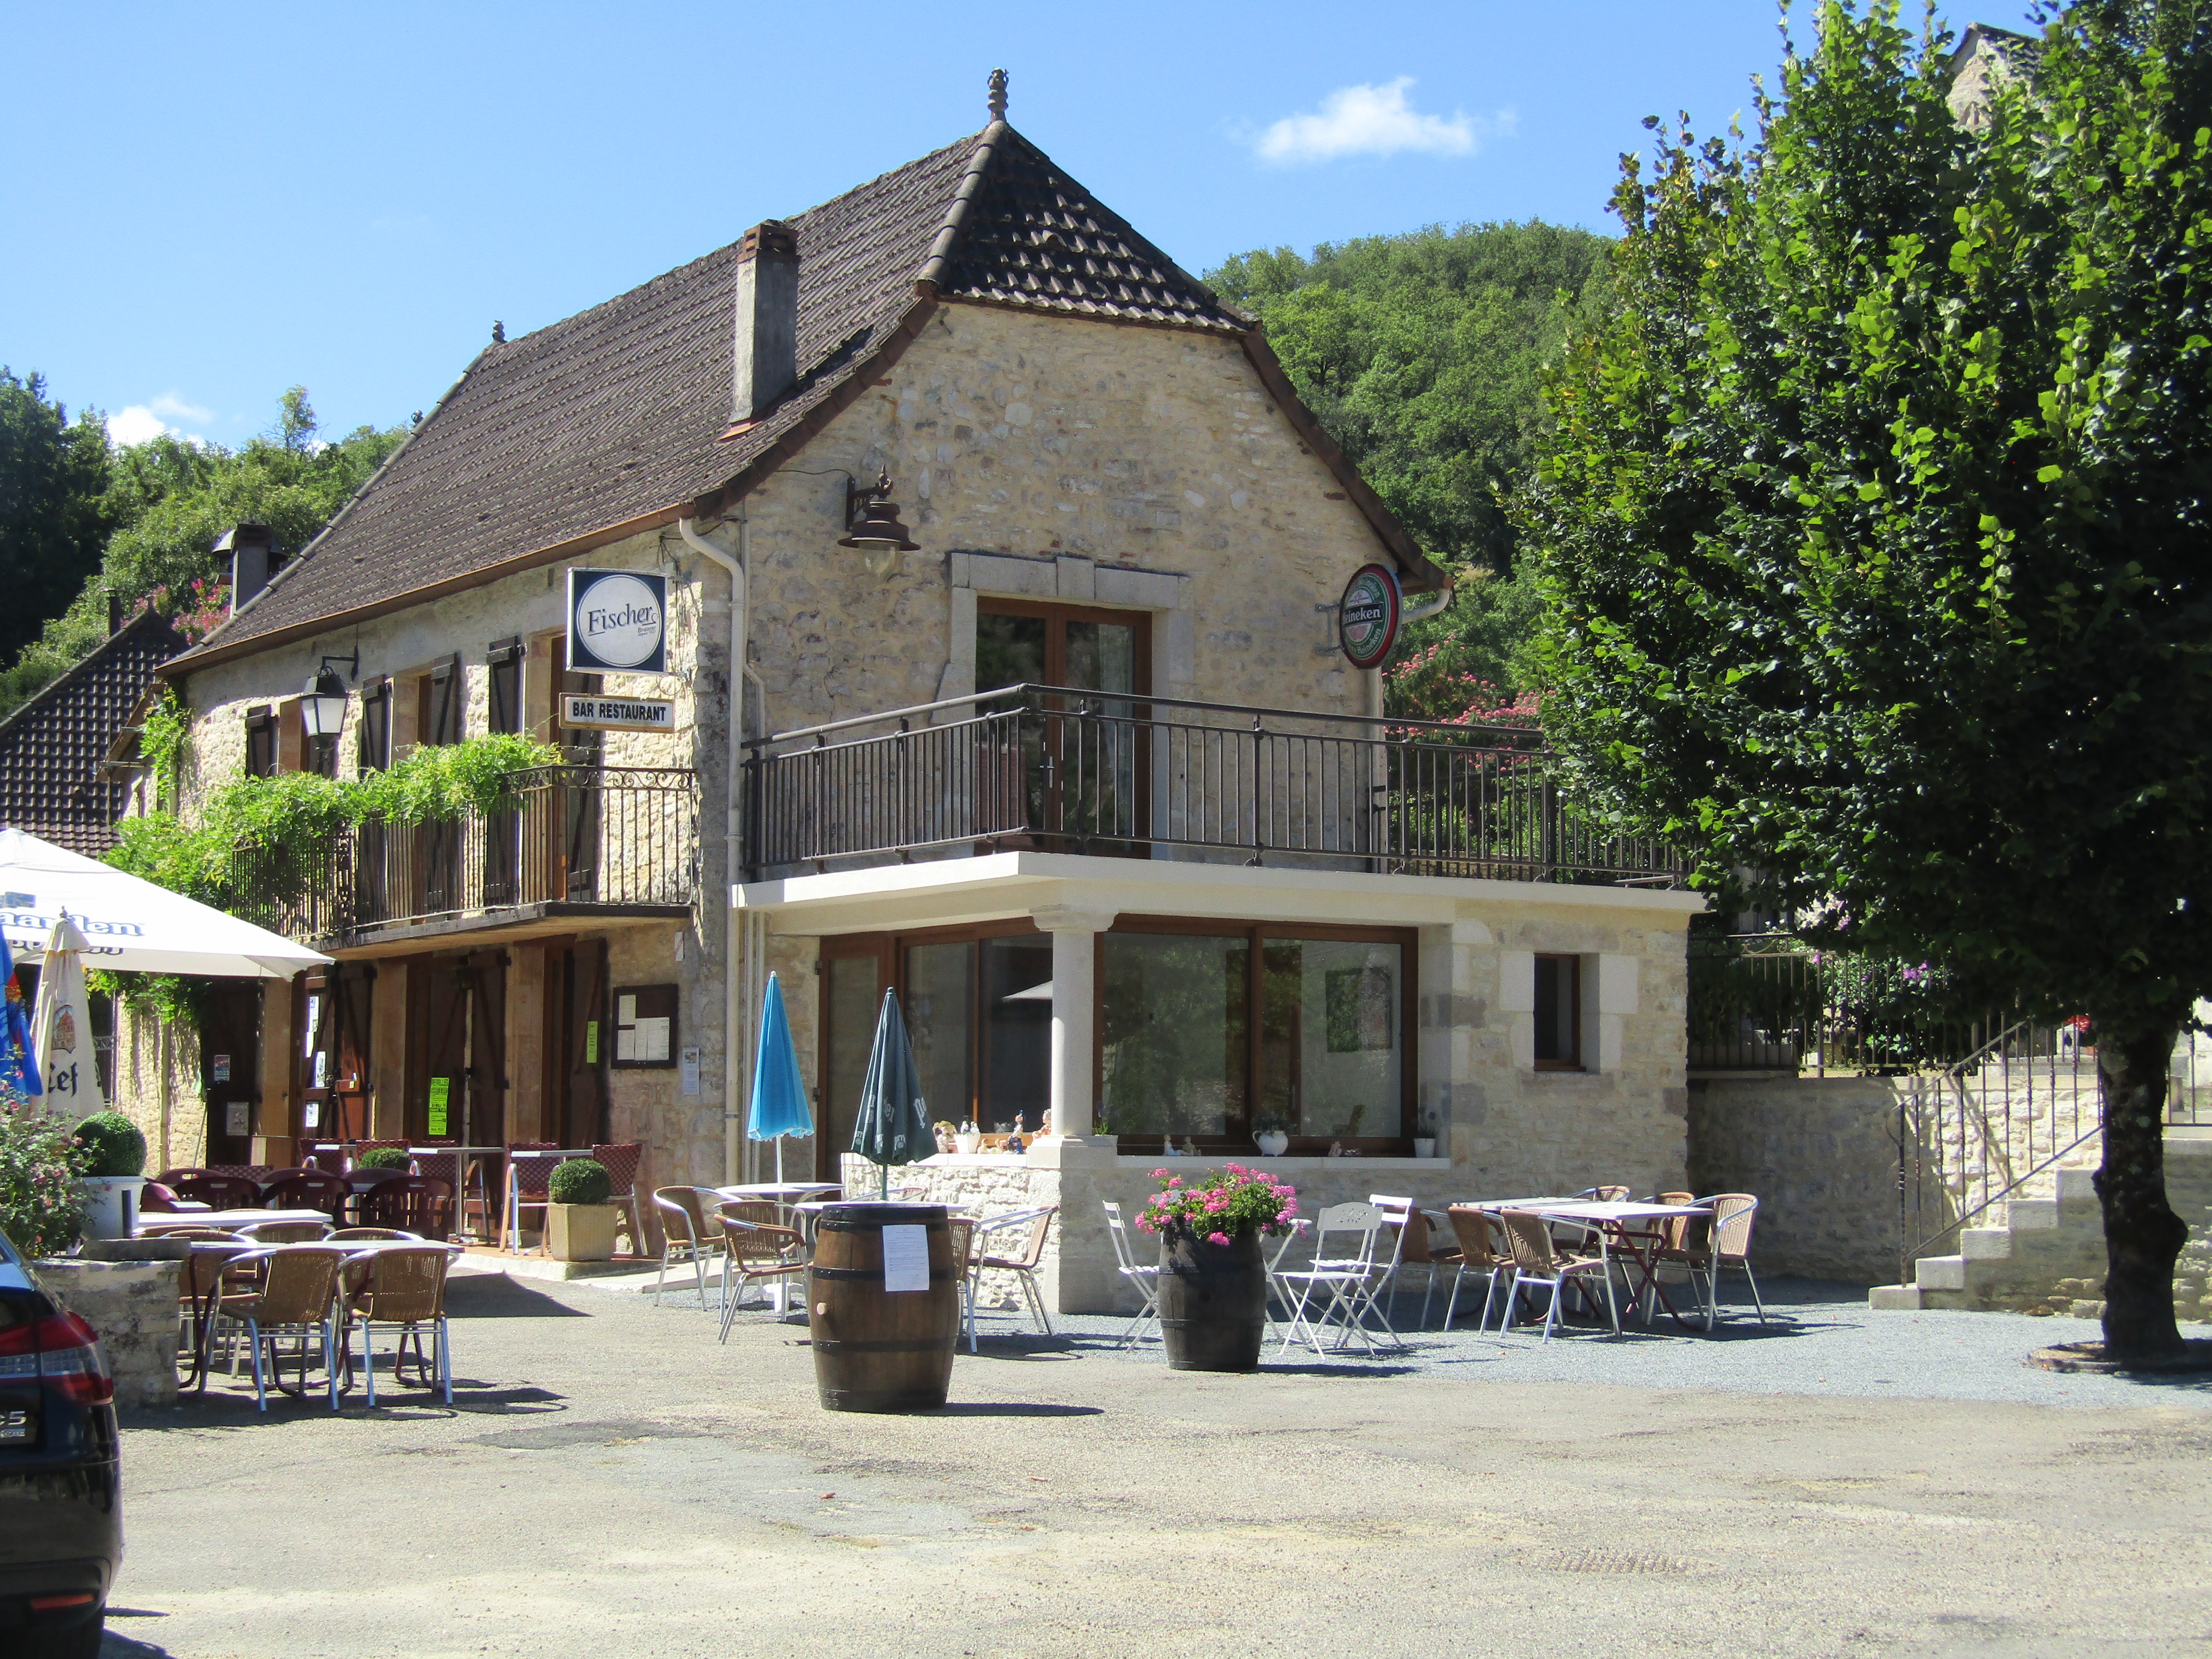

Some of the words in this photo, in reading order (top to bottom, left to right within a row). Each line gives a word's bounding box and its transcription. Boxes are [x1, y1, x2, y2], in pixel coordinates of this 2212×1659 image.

[587, 603, 653, 633] Fischer
[573, 702, 594, 717] BAR
[599, 703, 666, 721] RESTAURANT
